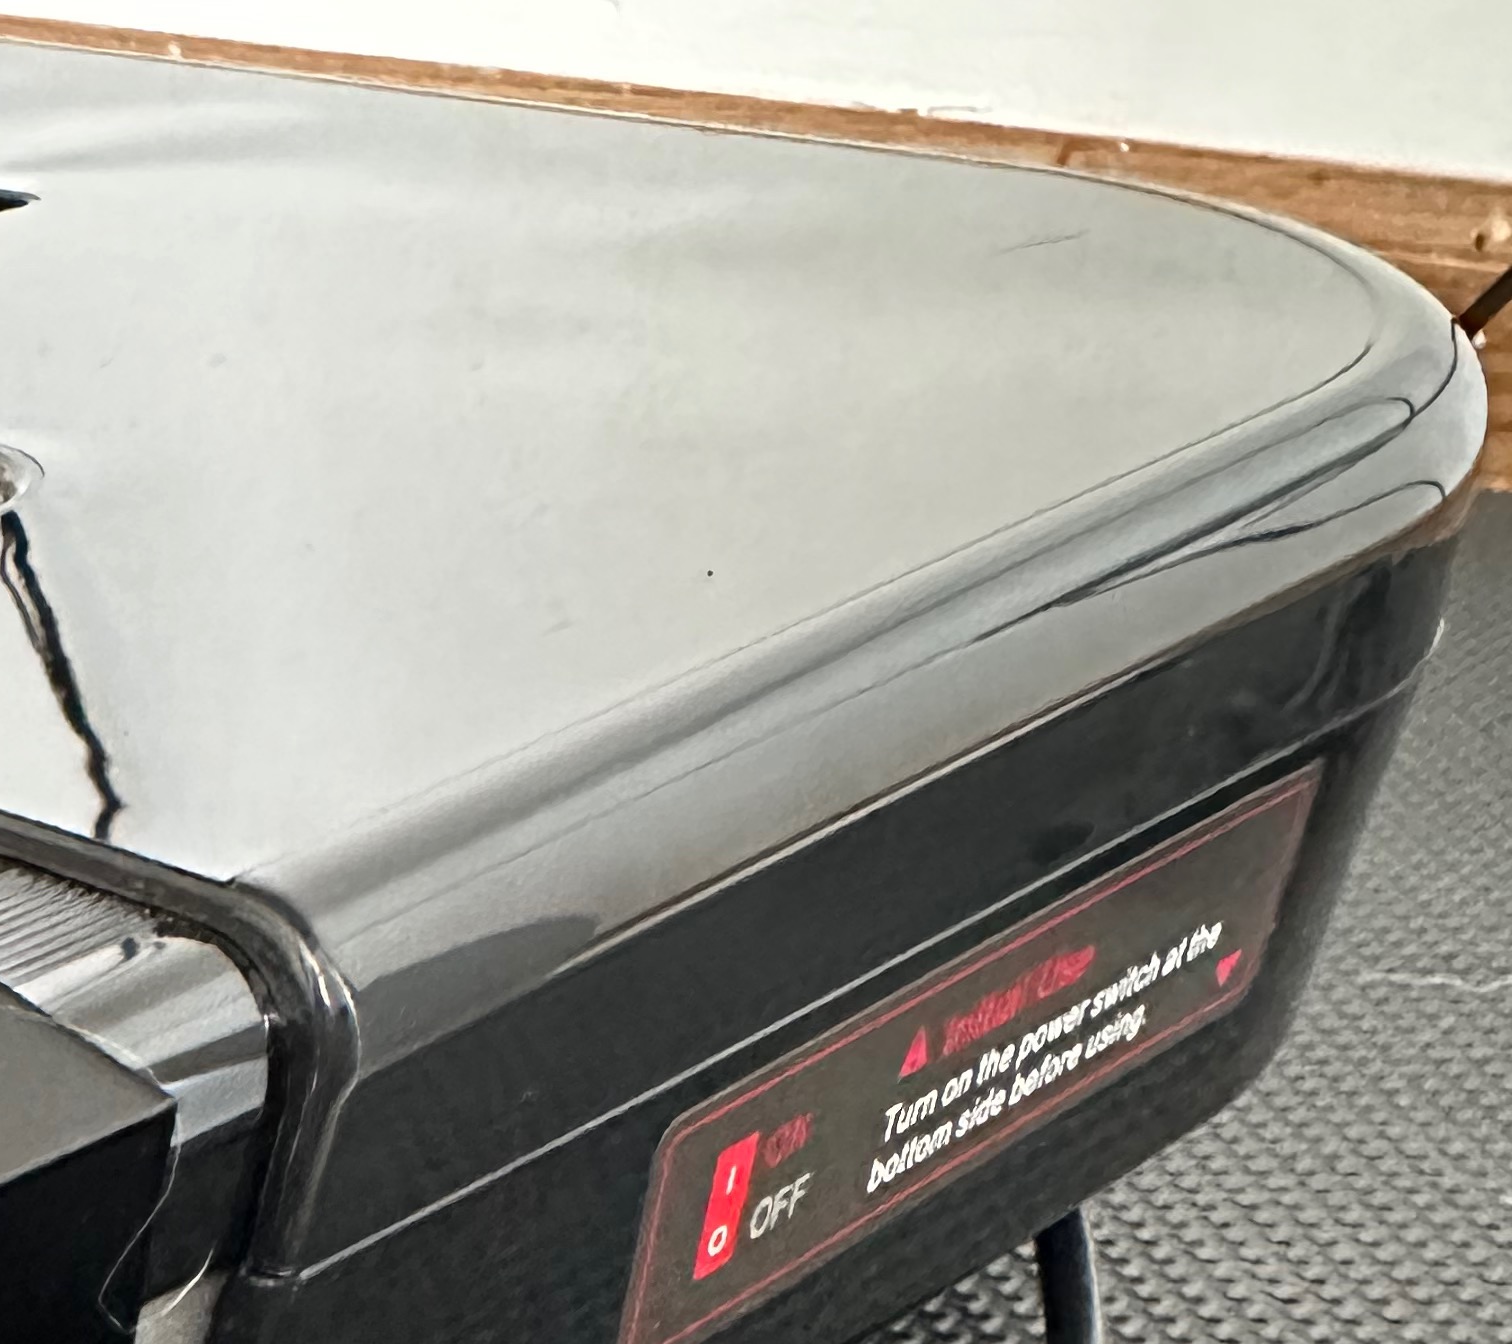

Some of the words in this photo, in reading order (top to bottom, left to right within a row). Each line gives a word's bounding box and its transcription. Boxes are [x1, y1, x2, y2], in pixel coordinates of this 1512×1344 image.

[884, 1088, 938, 1142] Turn
[941, 1067, 974, 1108] on
[976, 1042, 1016, 1086] the
[1015, 998, 1092, 1071] power
[1090, 951, 1161, 1019] switch
[1161, 936, 1188, 977] at
[1187, 920, 1224, 963] the
[866, 1120, 953, 1195] bottom
[954, 1087, 1007, 1139] side
[1007, 1042, 1083, 1106] before
[749, 1171, 815, 1240] OFF
